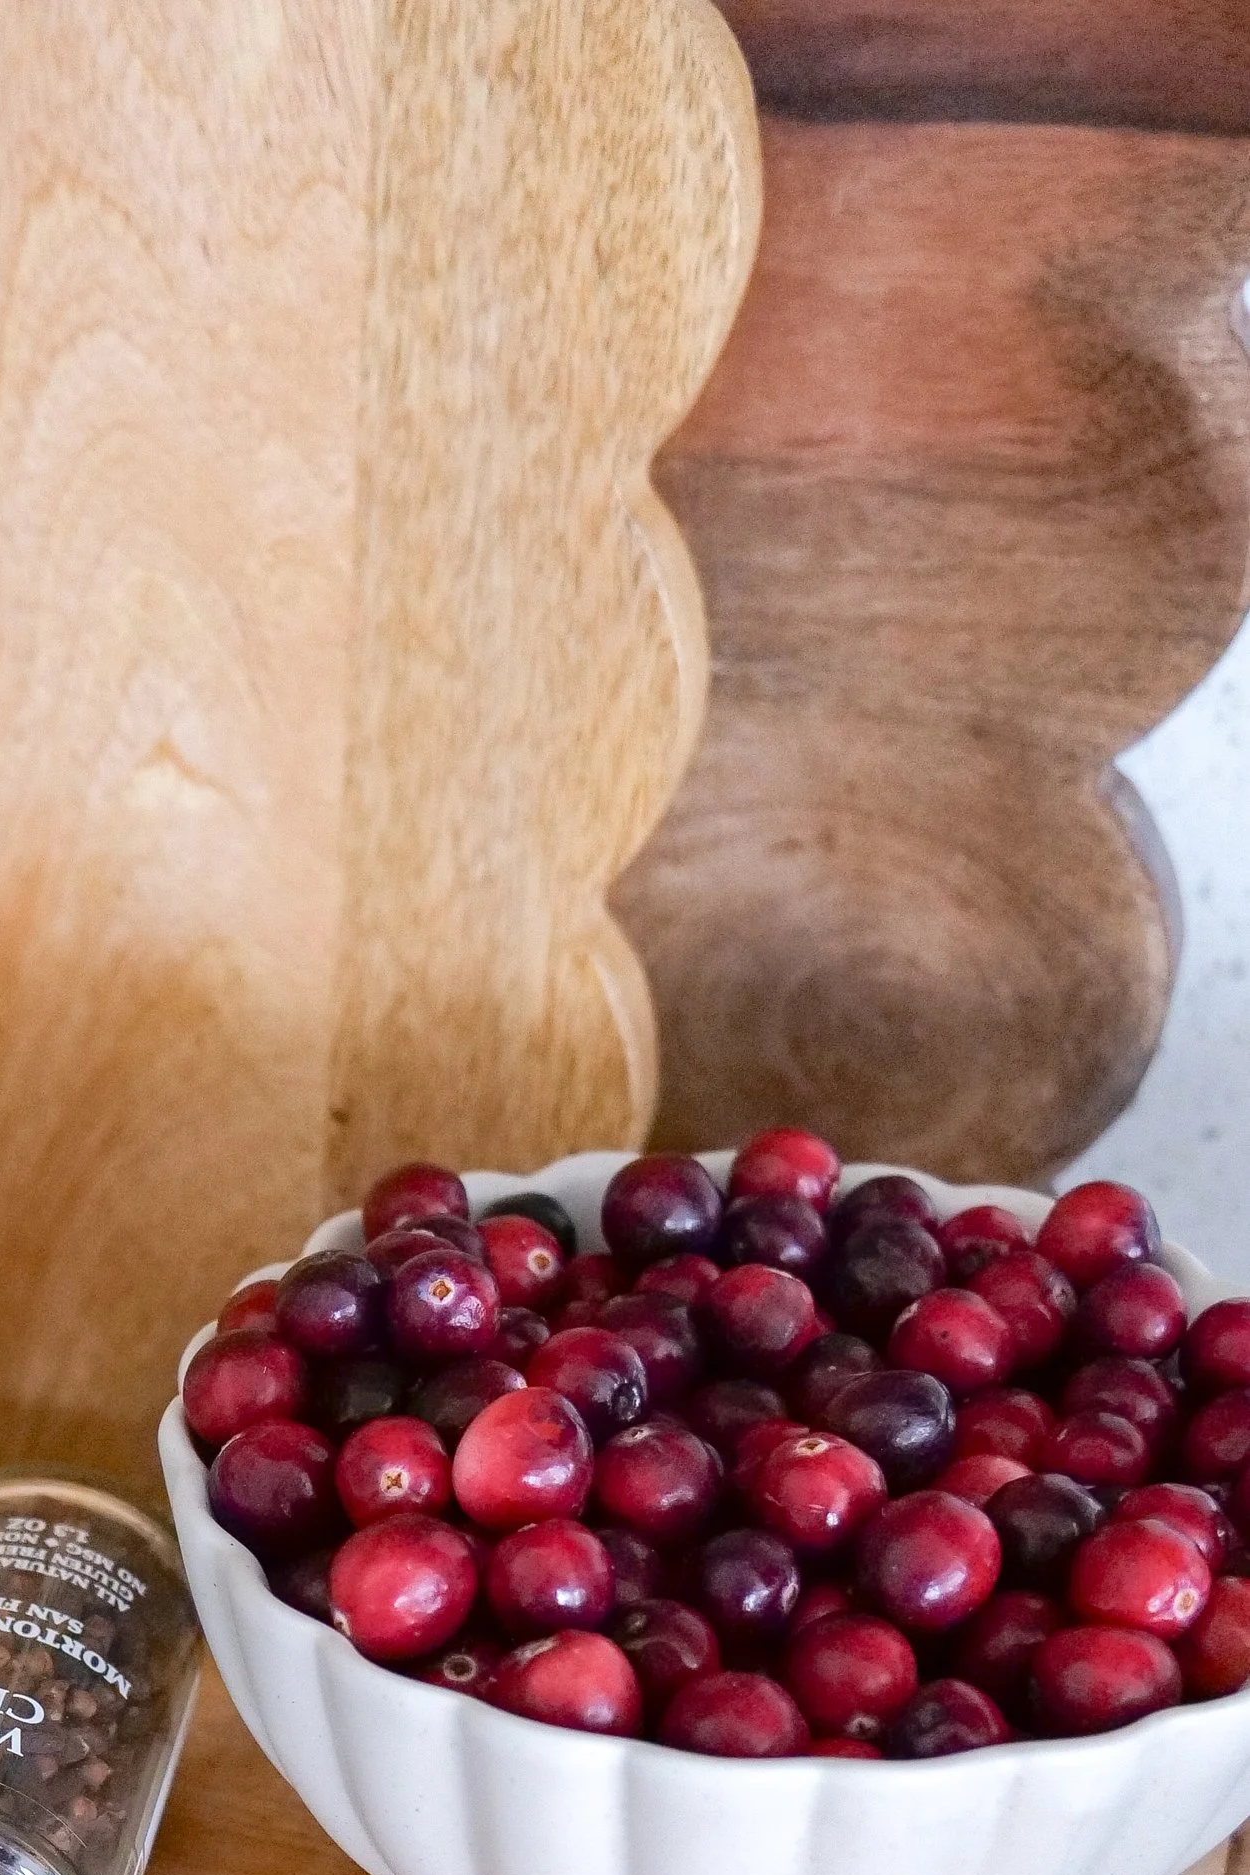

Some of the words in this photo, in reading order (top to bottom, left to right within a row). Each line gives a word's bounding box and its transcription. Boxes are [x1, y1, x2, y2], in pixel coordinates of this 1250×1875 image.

[5, 1517, 47, 1532] OZ
[65, 1542, 115, 1572] MSG
[51, 1552, 135, 1602] GLUTEN
[116, 1567, 147, 1597] NO
[93, 1583, 131, 1612] ALL
[25, 1603, 85, 1635] SAN
